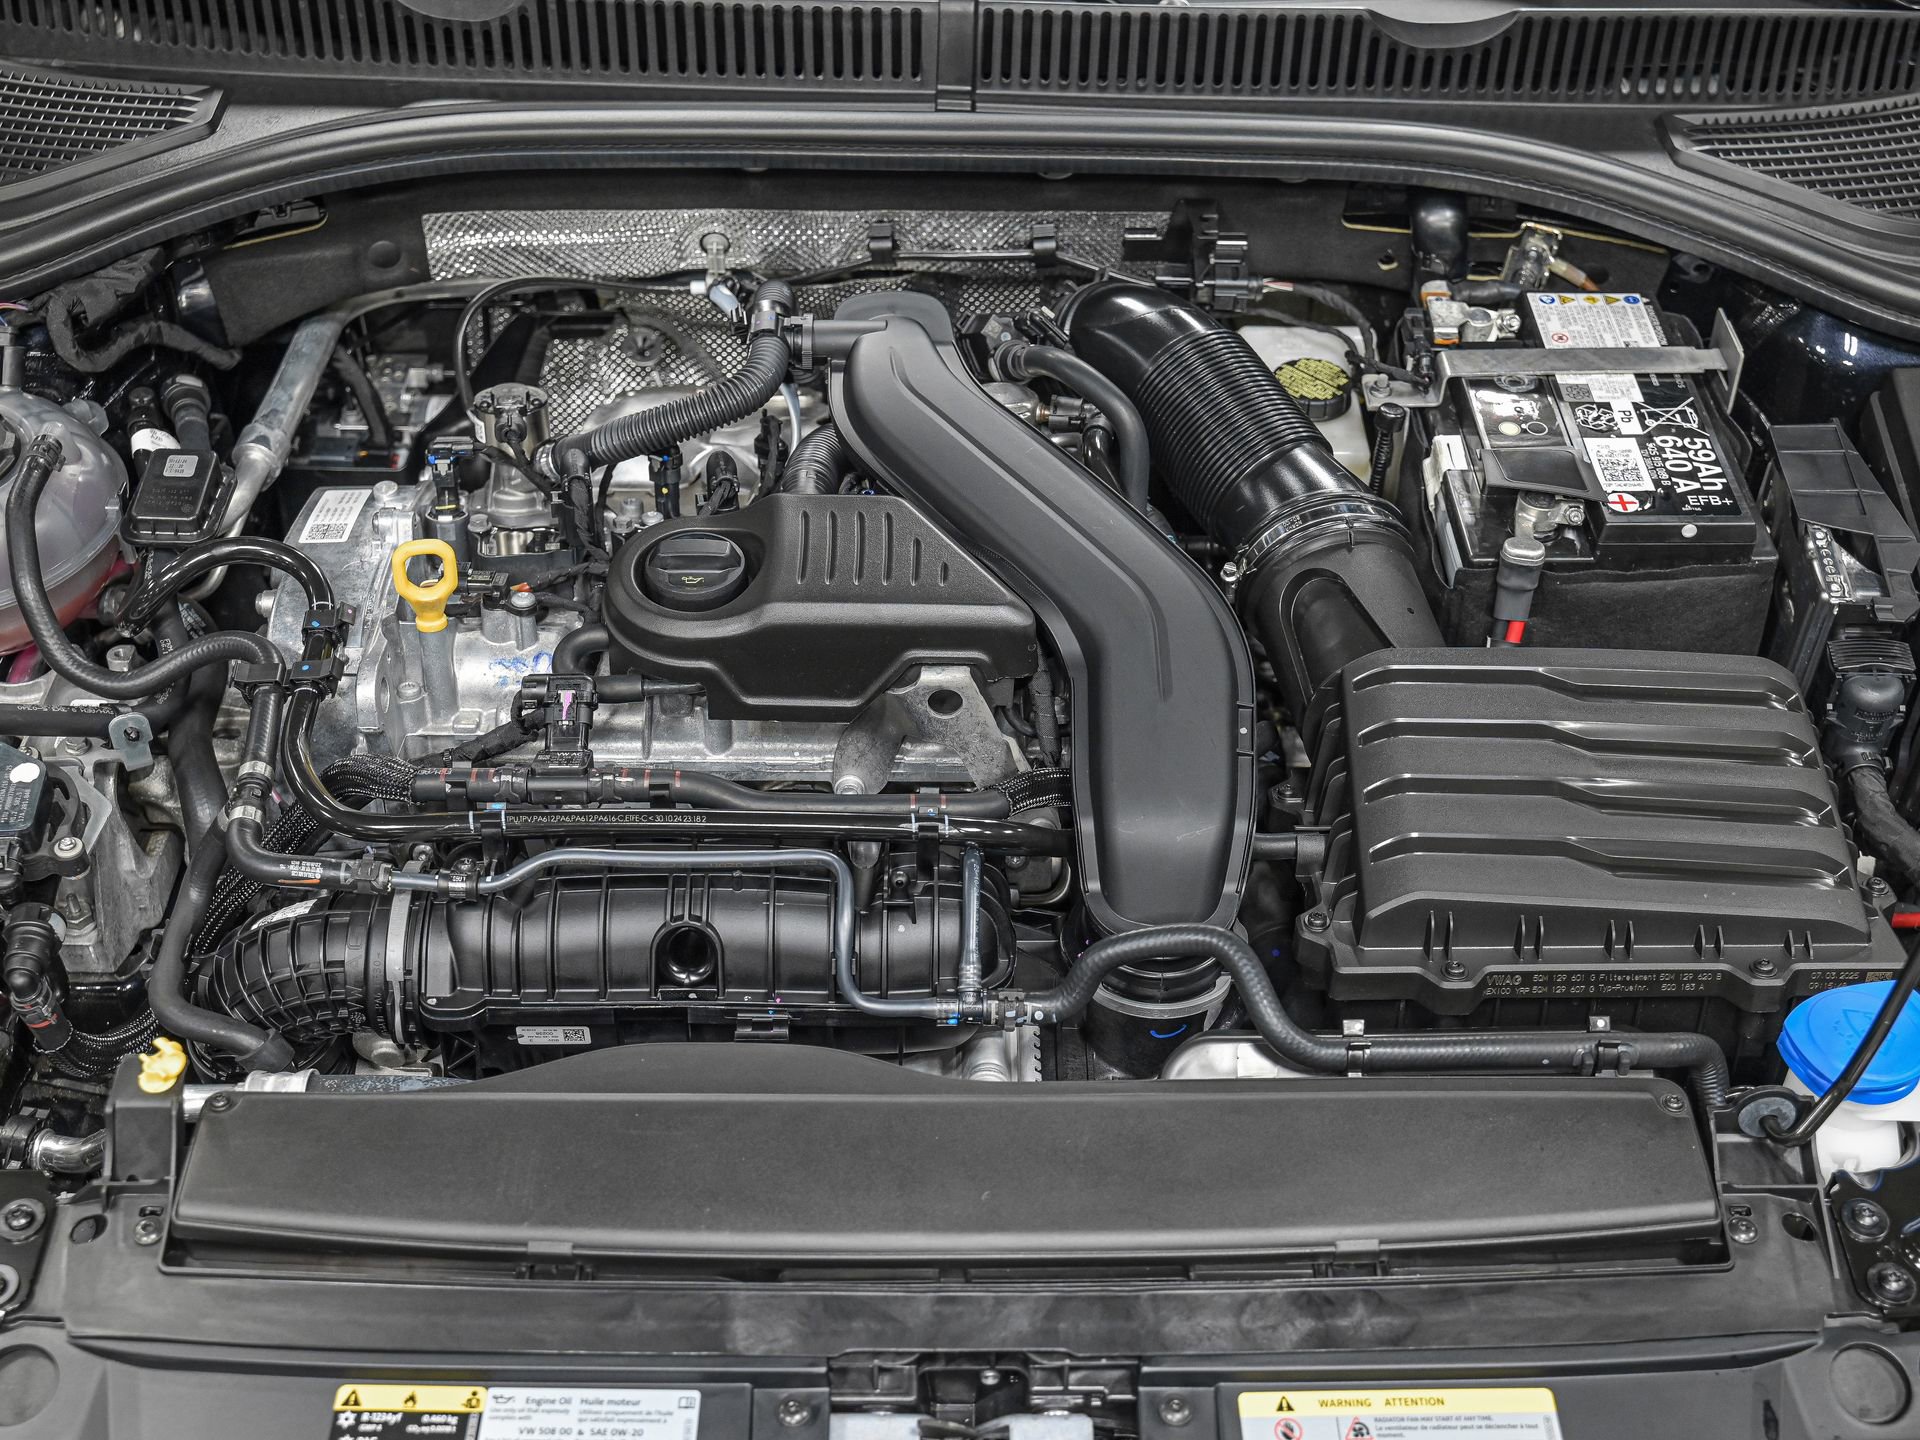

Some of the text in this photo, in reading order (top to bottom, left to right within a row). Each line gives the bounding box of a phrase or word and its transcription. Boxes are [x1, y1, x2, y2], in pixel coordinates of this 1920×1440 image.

[1618, 410, 1633, 423] Pb
[1653, 435, 1693, 472] 640
[1683, 437, 1727, 490] 59Ah
[1671, 476, 1701, 494] A
[1687, 495, 1733, 506] EFB+
[1553, 974, 1567, 982] 129
[1571, 974, 1585, 982] 601
[1598, 973, 1657, 982] Filterelement
[1680, 973, 1694, 981] 129
[1697, 973, 1713, 981] 620
[1810, 972, 1860, 980] 07.03.2025
[1552, 986, 1567, 994] 129
[1570, 986, 1585, 994] 607
[1681, 983, 1696, 991] 183
[525, 1397, 557, 1407] Engine
[559, 1397, 573, 1405] Oil
[580, 1398, 604, 1406] Huile
[1318, 1397, 1445, 1408] WARNING ATTENTION
[360, 1412, 402, 1425] R-1234yf
[519, 1427, 535, 1435] VW
[539, 1427, 557, 1435] 508
[559, 1427, 573, 1435] 00
[590, 1428, 608, 1436] SAE
